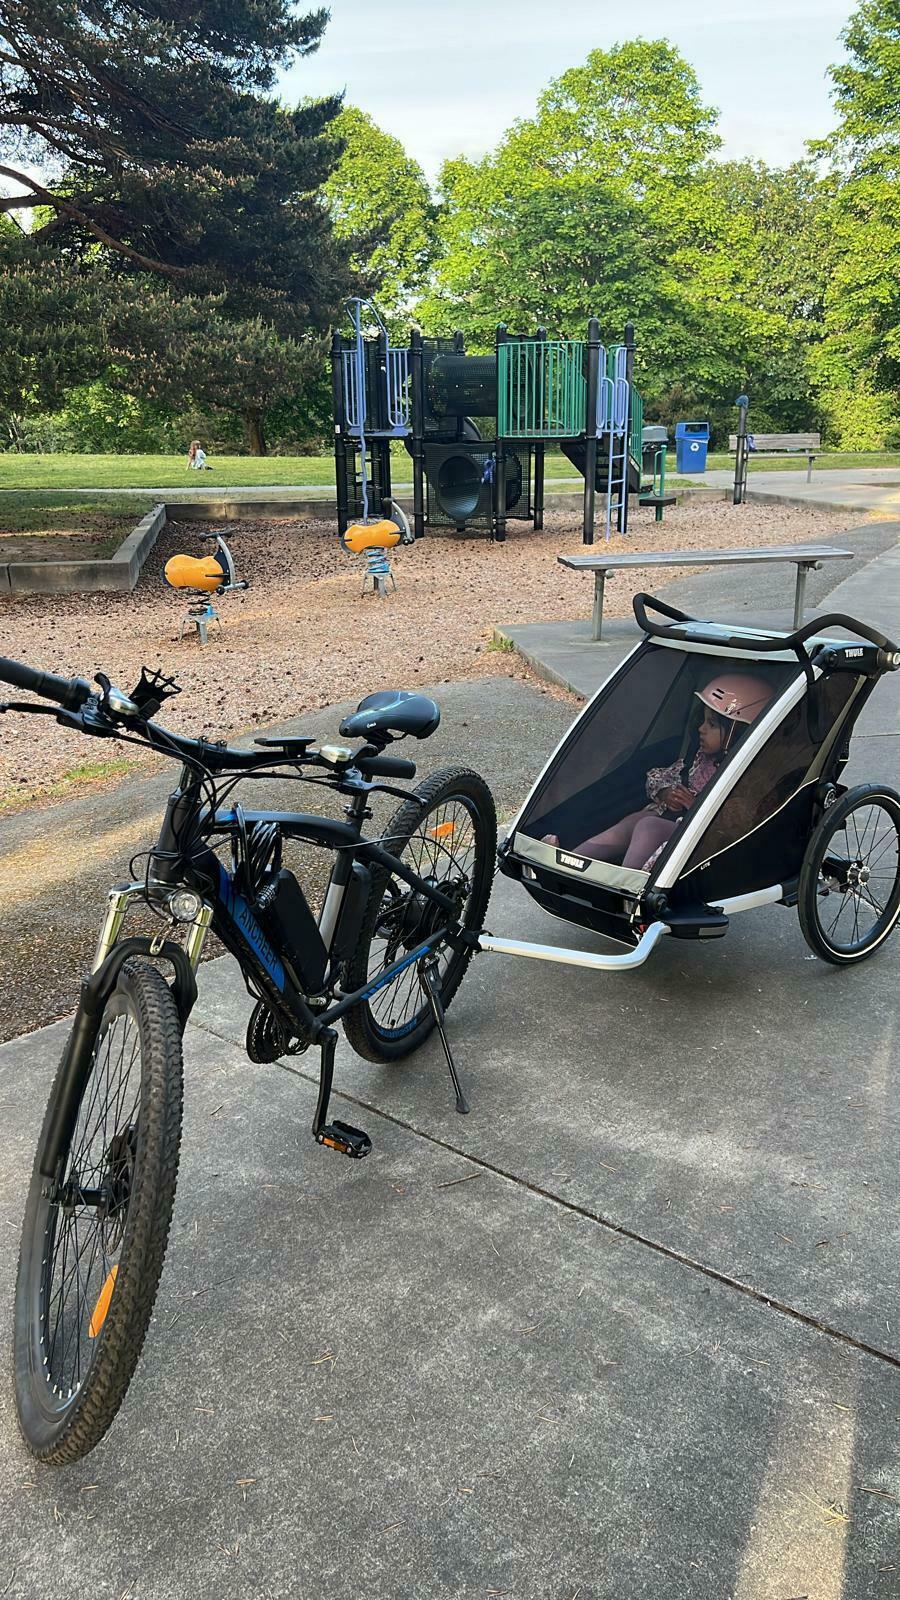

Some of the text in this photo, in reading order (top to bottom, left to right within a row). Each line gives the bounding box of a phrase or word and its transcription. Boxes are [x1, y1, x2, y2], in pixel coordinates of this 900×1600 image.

[844, 647, 864, 658] THULE
[560, 853, 585, 869] THULE
[239, 907, 279, 971] ANCHEER
